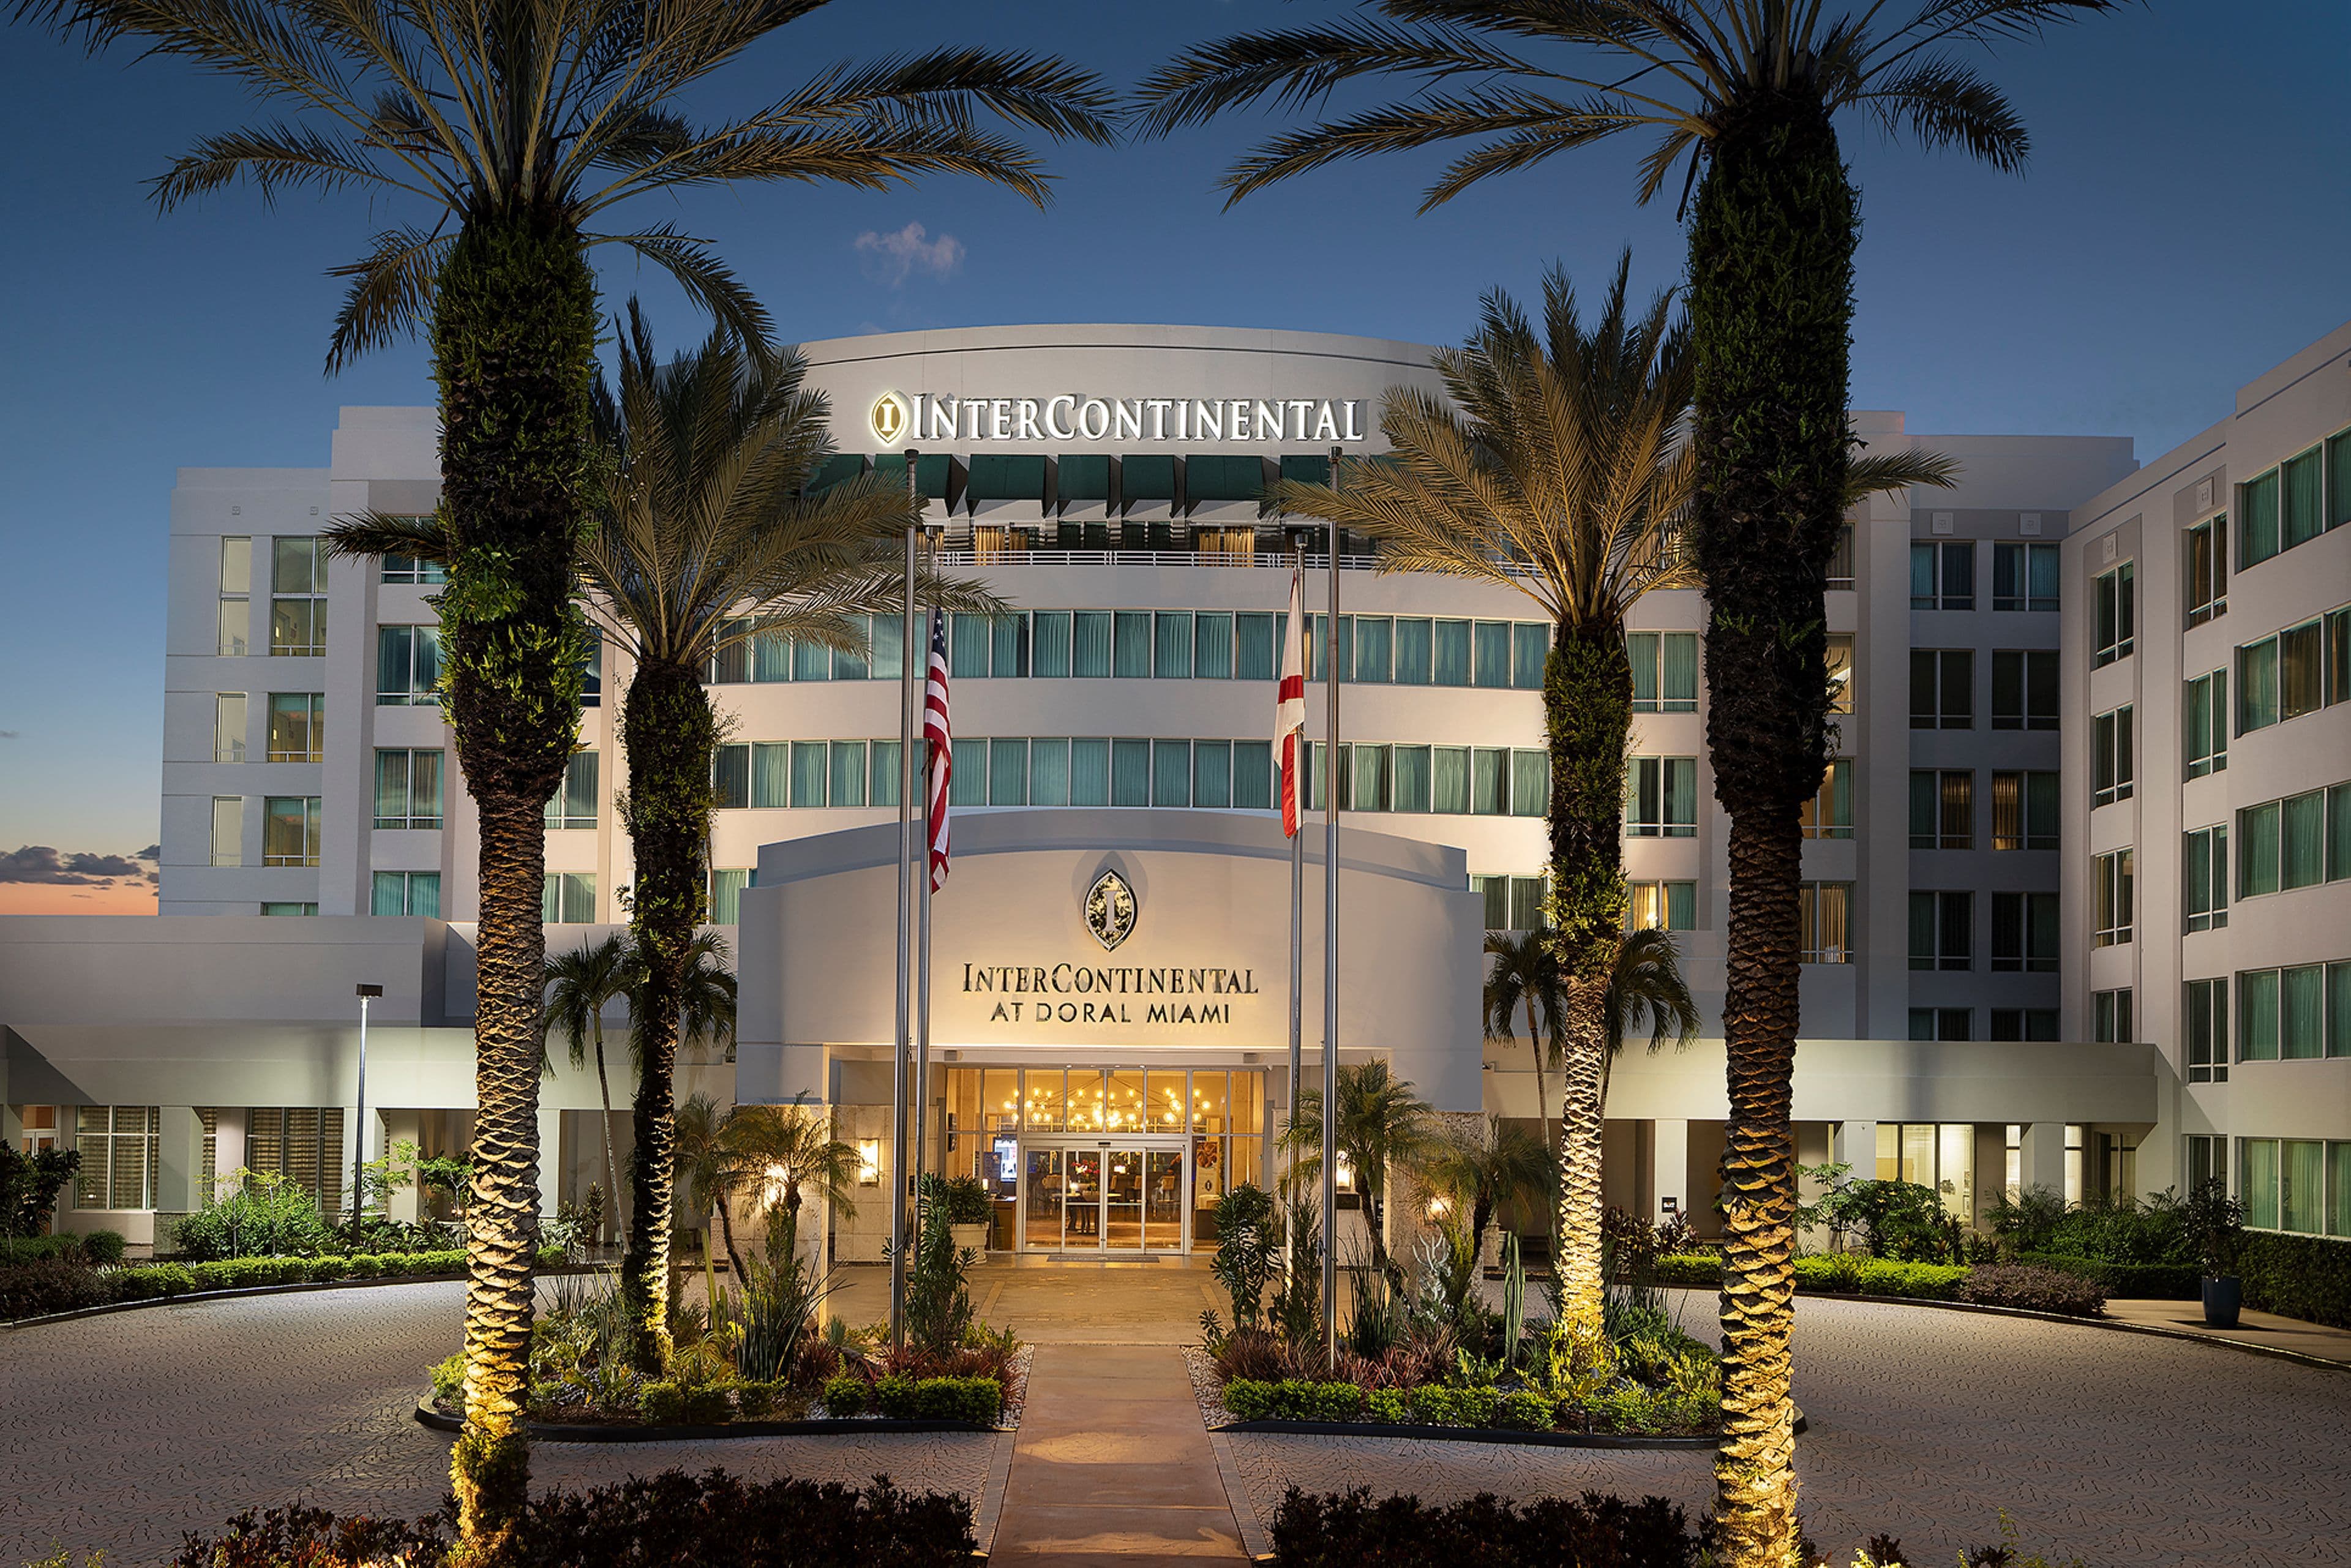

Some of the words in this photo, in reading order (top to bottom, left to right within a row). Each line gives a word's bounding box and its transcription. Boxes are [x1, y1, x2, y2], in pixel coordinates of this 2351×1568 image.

[912, 394, 1364, 441] INTERCONTINENTAL
[963, 963, 1259, 994] INTERCONTINENTAL
[991, 1002, 1023, 1022] AT
[1037, 1002, 1131, 1023] DORAL
[1147, 1003, 1229, 1024] MIAMI
